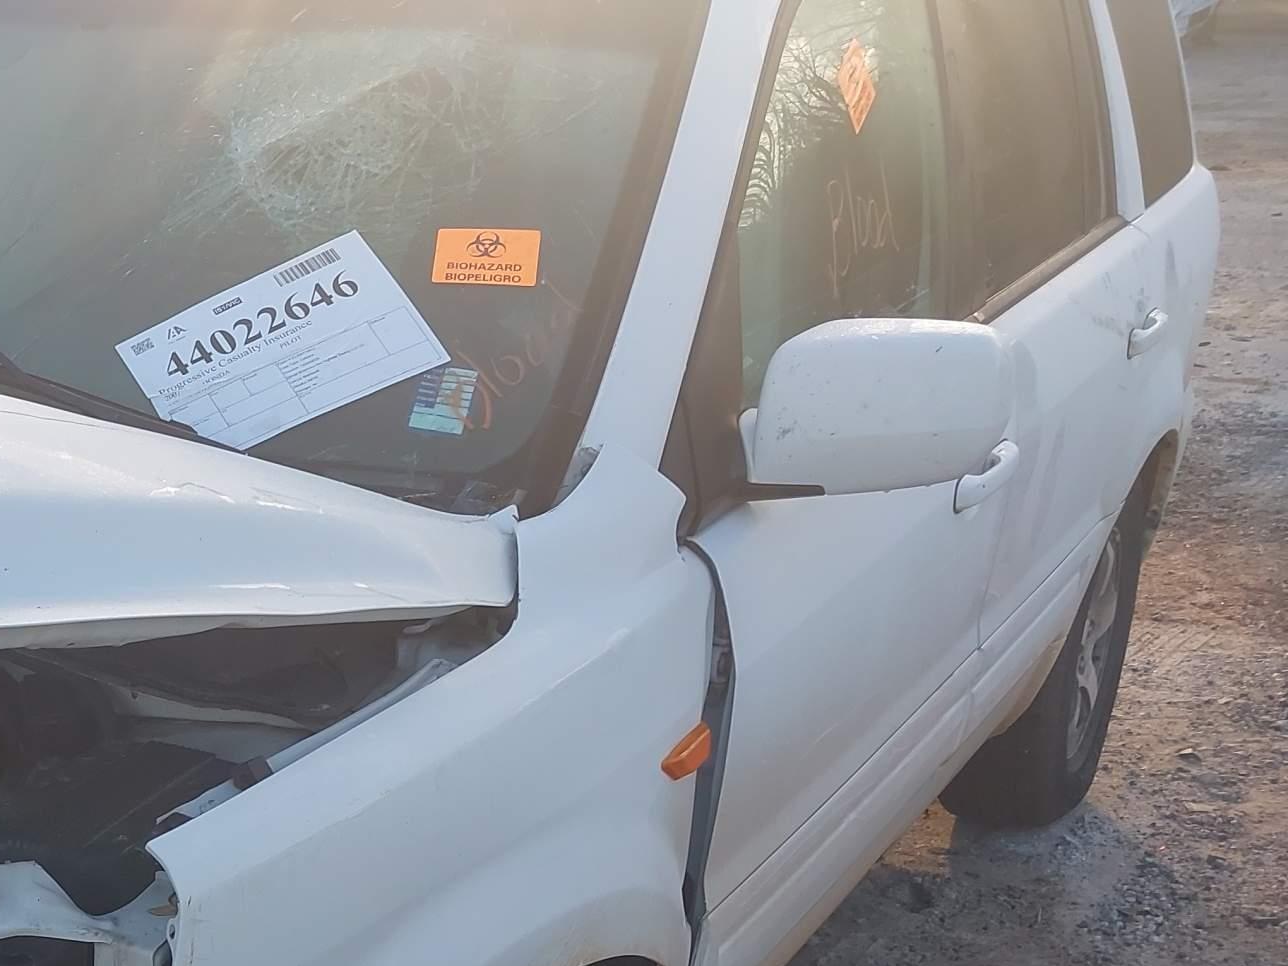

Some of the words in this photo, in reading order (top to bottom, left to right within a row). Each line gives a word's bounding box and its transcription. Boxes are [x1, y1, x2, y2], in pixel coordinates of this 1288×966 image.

[444, 272, 522, 283] BIOPELIGRO
[446, 261, 522, 272] BIOHAZARD
[166, 269, 359, 377] 44022646
[158, 364, 217, 395] Progressive
[218, 343, 261, 368] Casualty
[263, 320, 312, 346] Insurance
